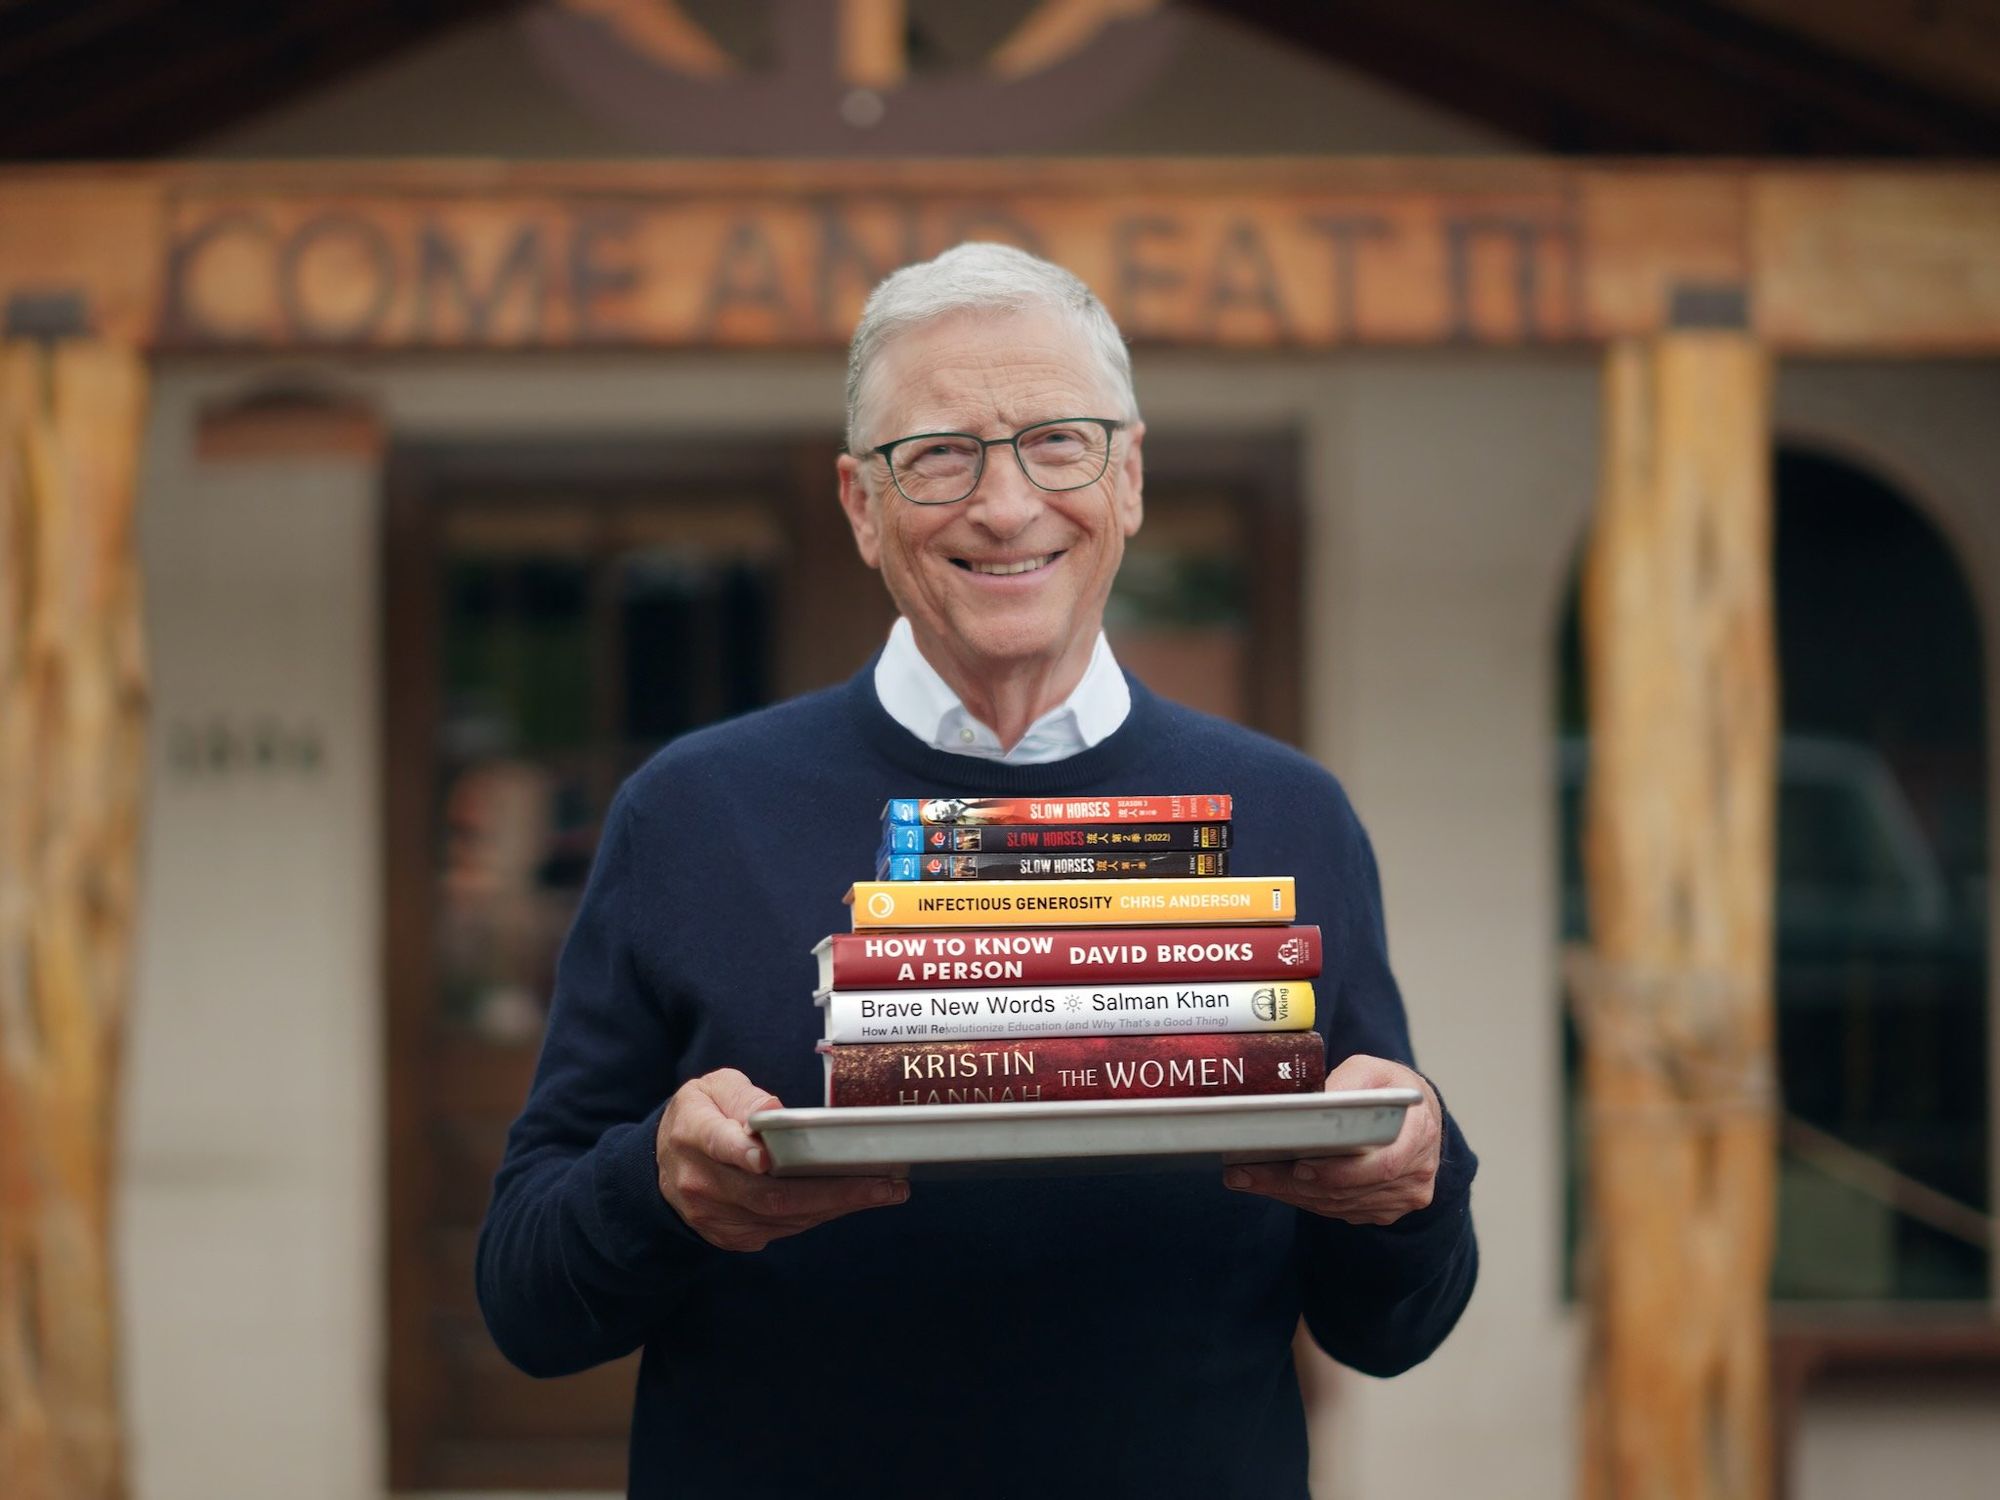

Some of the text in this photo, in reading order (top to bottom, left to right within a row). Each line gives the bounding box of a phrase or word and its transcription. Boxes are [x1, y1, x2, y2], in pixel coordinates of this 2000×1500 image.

[163, 203, 648, 338] COME
[1110, 210, 1390, 338] EAT
[1030, 801, 1111, 819] SLOW HORSES
[1007, 831, 1085, 847] SLOW HORSES
[1144, 833, 1171, 842] (2022)
[1020, 858, 1094, 874] SLOW HORSES
[919, 894, 1250, 911] INFECTIOUS GENEROSITY CHRIS ANDERSON
[865, 937, 1053, 958] HOW TO KNOW
[1070, 943, 1254, 965] DAVID BROOKS
[897, 961, 1023, 981] A PERSON
[861, 995, 1055, 1018] Brave New Words
[1092, 991, 1229, 1011] Salman Khan
[1279, 988, 1289, 1020] Viking
[862, 1026, 887, 1036] How
[891, 1026, 903, 1036] AI
[907, 1025, 927, 1035] Will
[930, 1022, 1004, 1034] Revolutionize
[1008, 1021, 1062, 1032] Education
[1065, 1019, 1089, 1031] (and
[1092, 1019, 1116, 1030] Why
[1120, 1018, 1151, 1028] That's
[1163, 1017, 1192, 1027] Good
[1196, 1016, 1229, 1028] Thing)
[904, 1051, 1245, 1089] KRISTIN THE WOMEN
